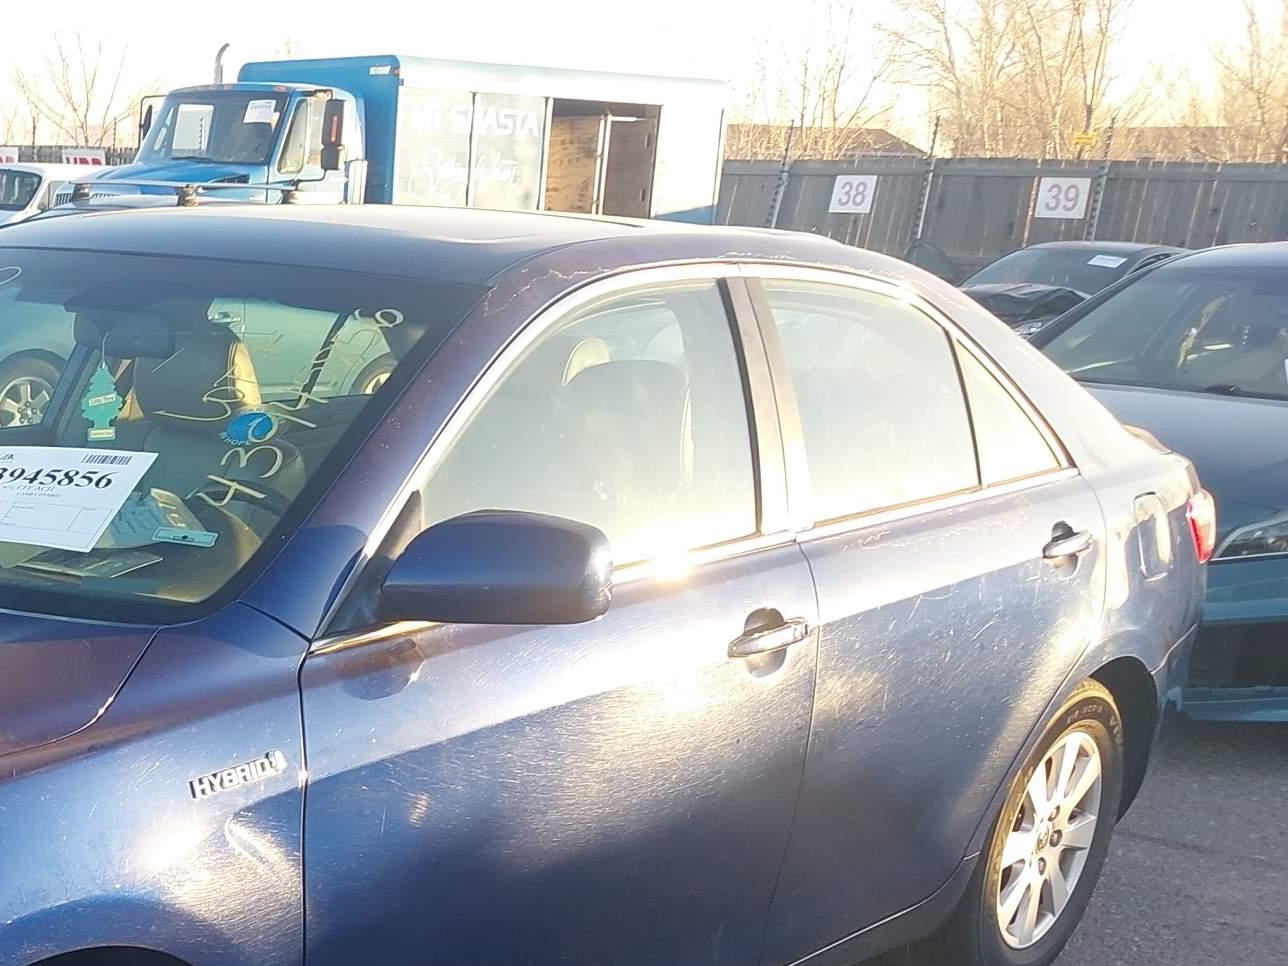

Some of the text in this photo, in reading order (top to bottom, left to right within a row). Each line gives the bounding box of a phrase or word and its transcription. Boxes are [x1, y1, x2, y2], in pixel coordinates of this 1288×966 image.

[838, 181, 868, 207] 38
[1044, 183, 1080, 212] 39
[189, 757, 273, 799] HYBRID
